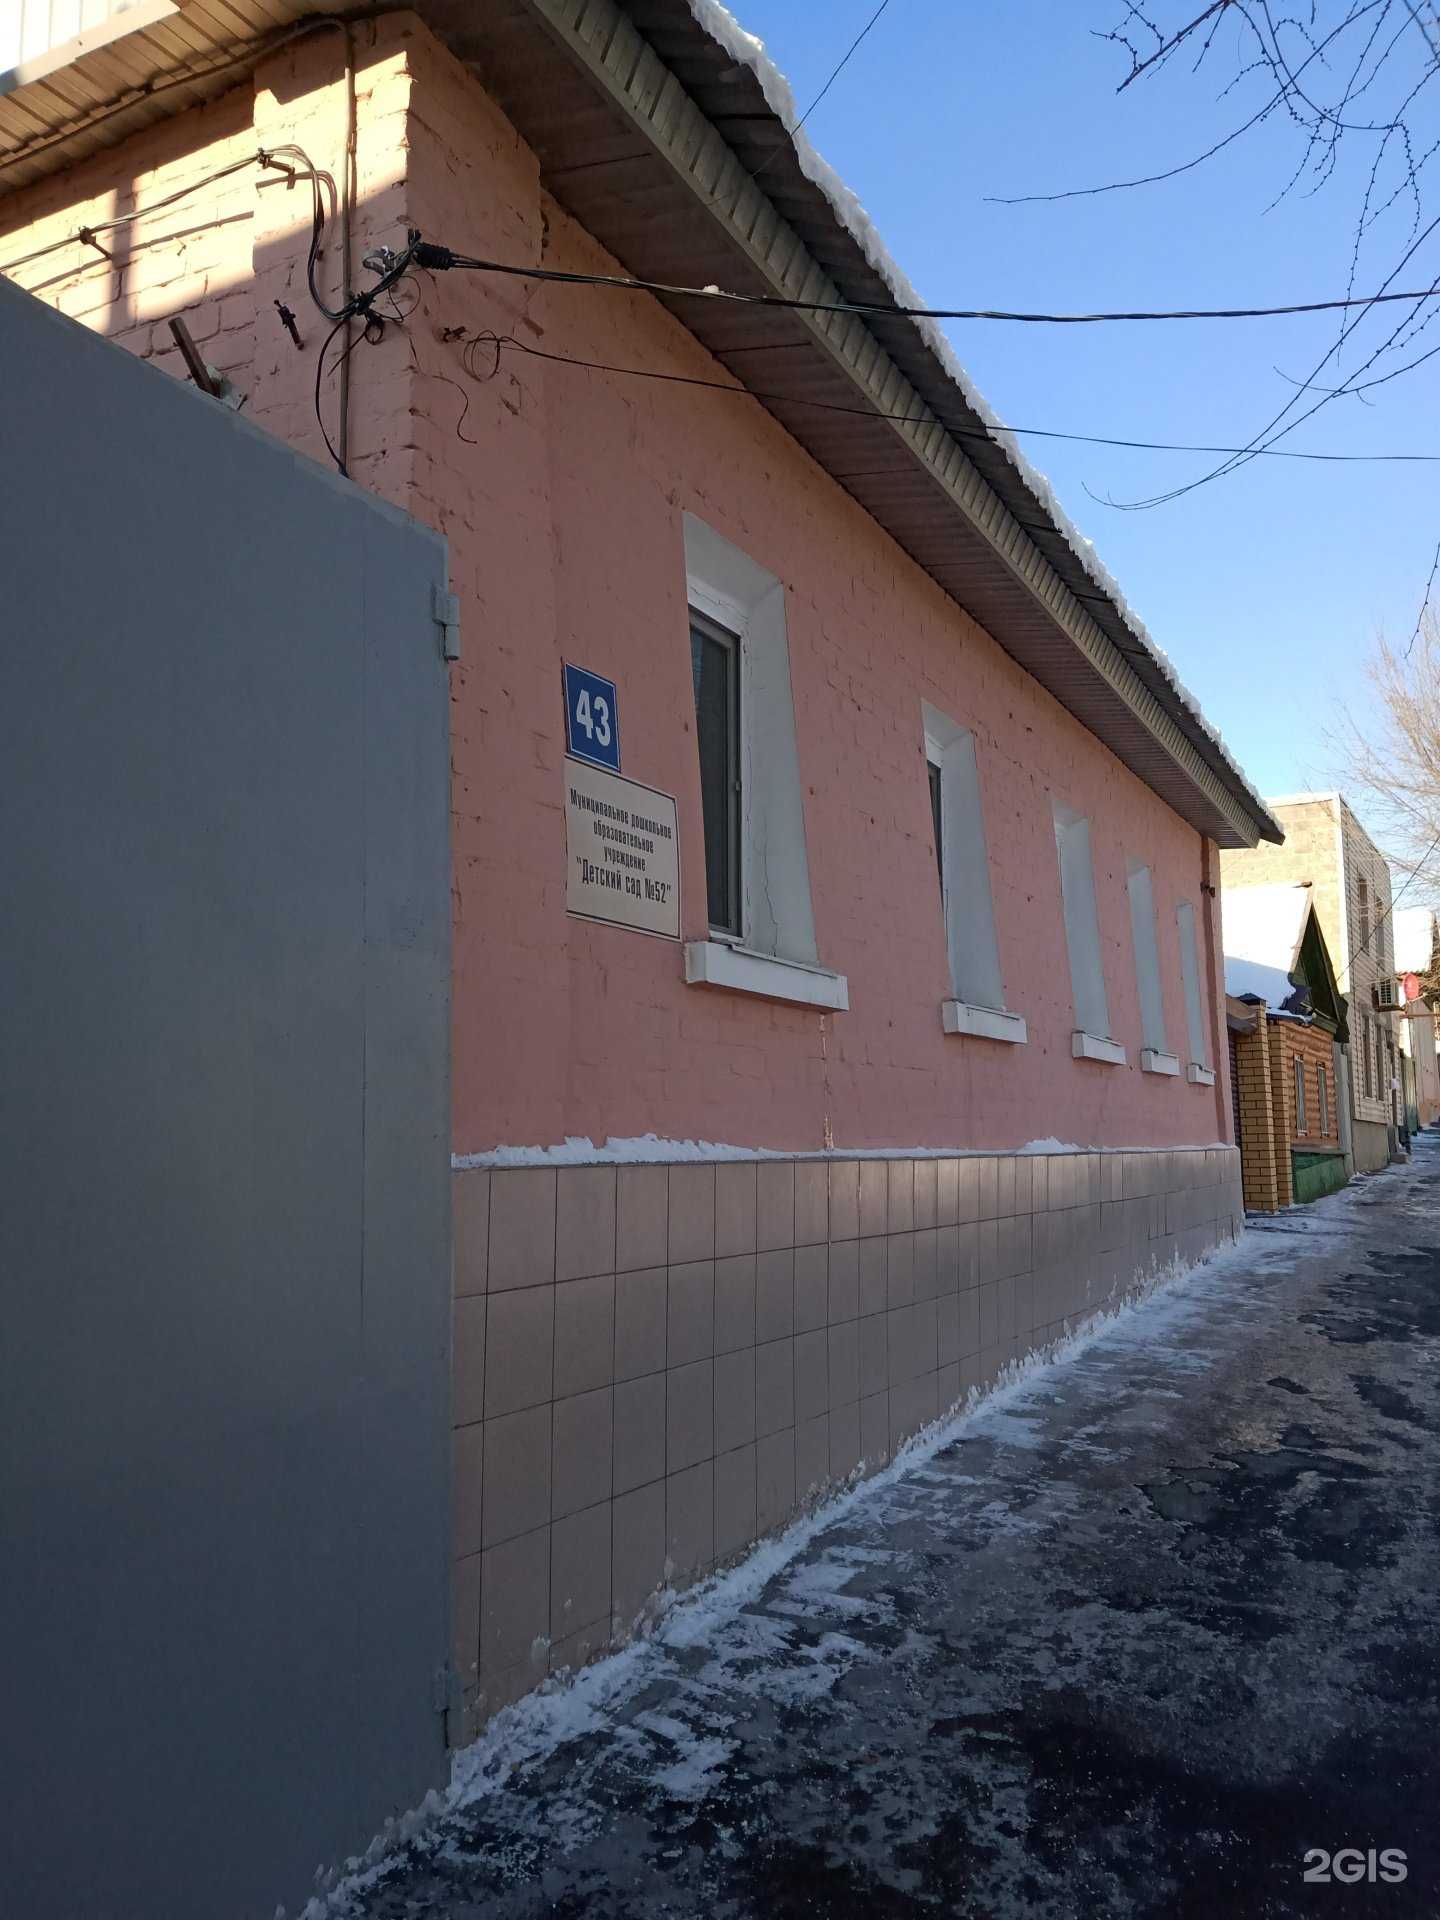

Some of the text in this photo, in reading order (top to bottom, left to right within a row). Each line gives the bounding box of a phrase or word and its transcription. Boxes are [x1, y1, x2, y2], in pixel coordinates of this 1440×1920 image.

[576, 689, 611, 746] 43
[570, 788, 672, 840] Муниципальное дошкольное
[593, 819, 654, 854] образовательное
[576, 856, 672, 904] "Детский сад №52"
[603, 847, 646, 872] учреждение
